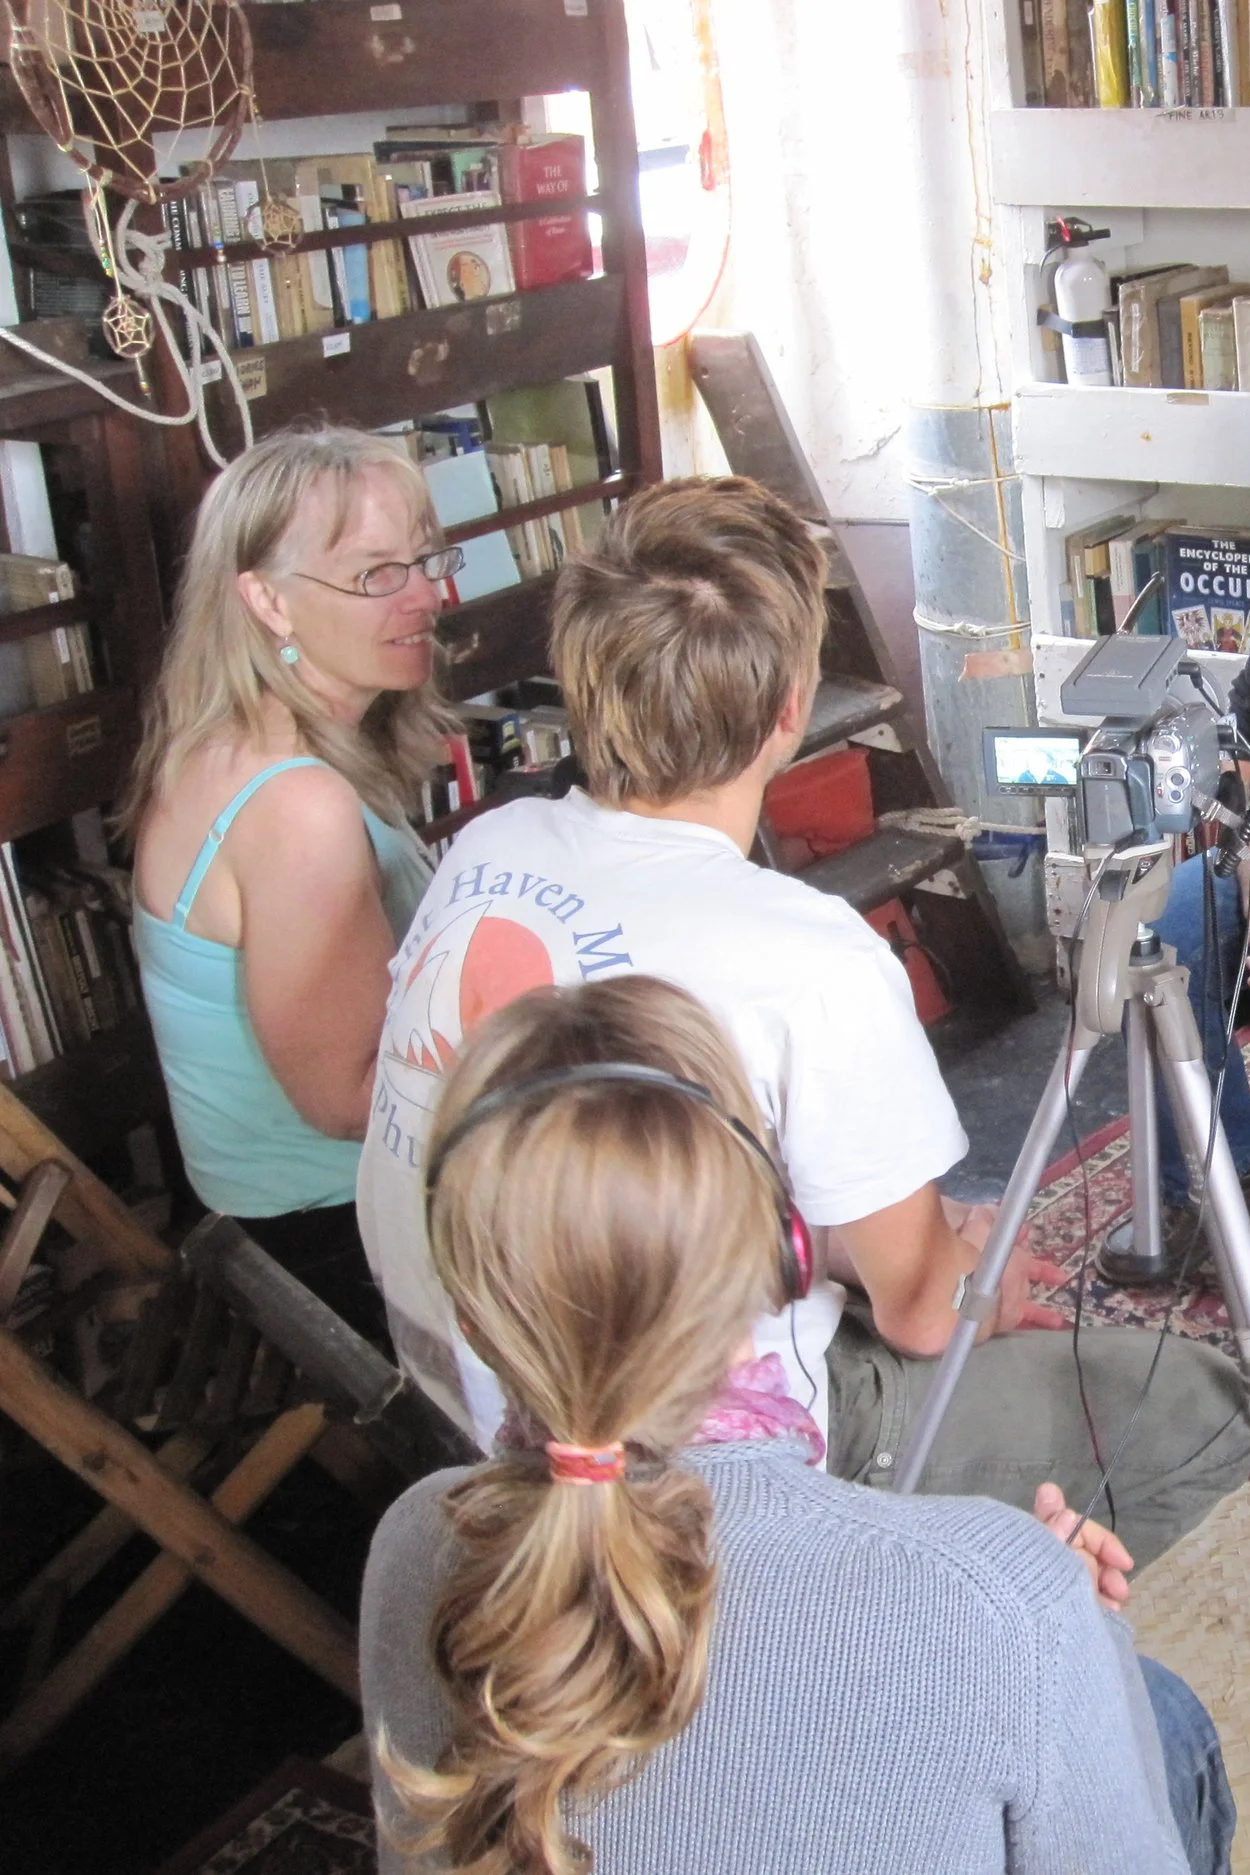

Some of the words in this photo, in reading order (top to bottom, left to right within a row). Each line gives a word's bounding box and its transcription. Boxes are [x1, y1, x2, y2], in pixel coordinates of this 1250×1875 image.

[1168, 111, 1192, 121] FINE
[1199, 109, 1225, 120] ARTS
[543, 165, 562, 178] THE
[536, 181, 557, 196] WAY
[557, 179, 569, 192] OF
[170, 217, 182, 251] COMM
[1211, 539, 1237, 551] THE
[1203, 561, 1219, 572] OF
[1224, 563, 1248, 576] THE
[445, 861, 585, 924] Haven
[572, 922, 634, 981] M
[372, 1080, 421, 1169] Phu
